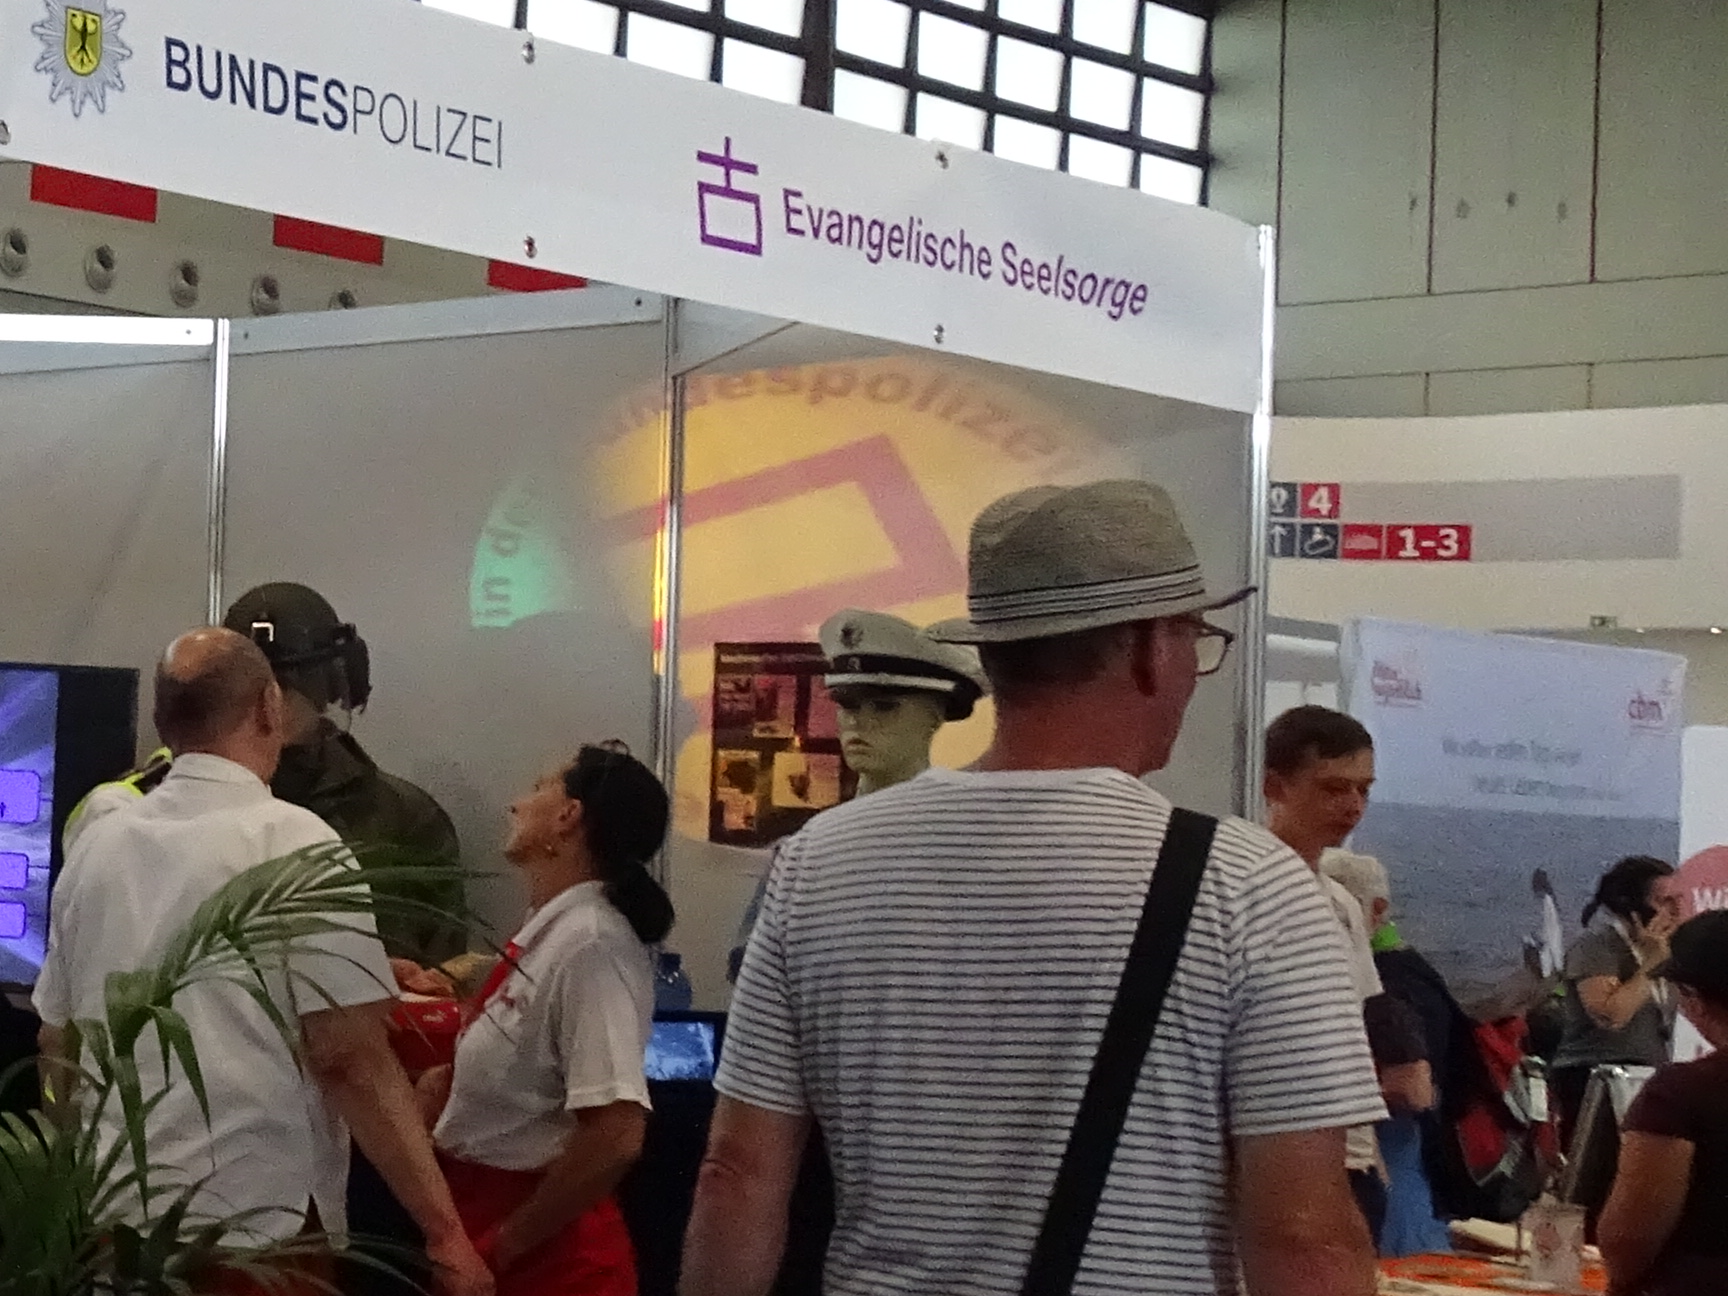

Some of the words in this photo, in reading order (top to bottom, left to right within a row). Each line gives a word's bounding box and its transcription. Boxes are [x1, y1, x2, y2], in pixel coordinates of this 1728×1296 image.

[163, 35, 504, 169] BUNDESPOLIZEI
[782, 187, 992, 281] Evangelische
[1001, 240, 1150, 322] Seelsorge
[1308, 485, 1333, 516] 4
[1398, 528, 1459, 558] 1-3
